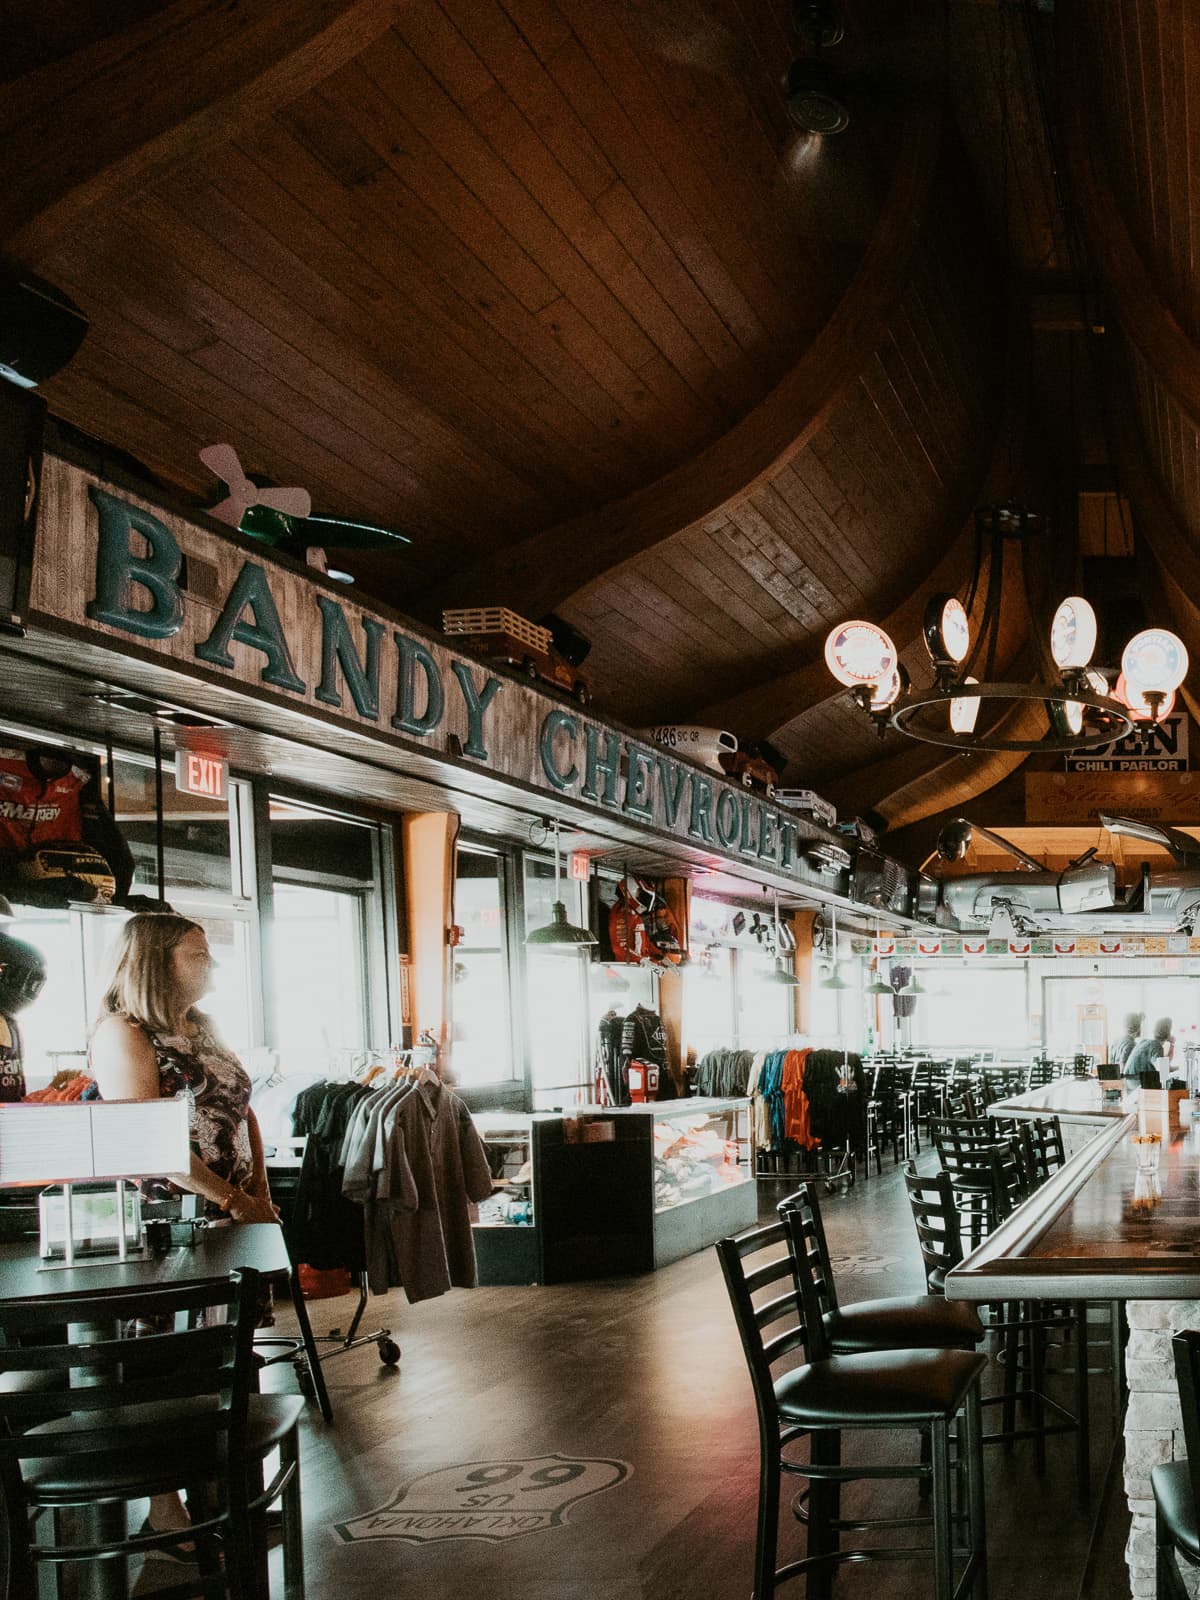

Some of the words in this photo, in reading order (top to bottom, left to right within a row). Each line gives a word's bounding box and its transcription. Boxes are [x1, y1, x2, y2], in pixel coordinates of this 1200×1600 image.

[87, 484, 503, 761] BANDY
[540, 709, 801, 870] CHEVROLET
[1075, 761, 1113, 772] CHILI
[1120, 760, 1178, 772] PARLOR
[187, 755, 223, 797] EXIT
[573, 856, 588, 877] EXIT
[461, 1493, 516, 1507] US
[367, 1515, 546, 1530] OKLAHOMA
